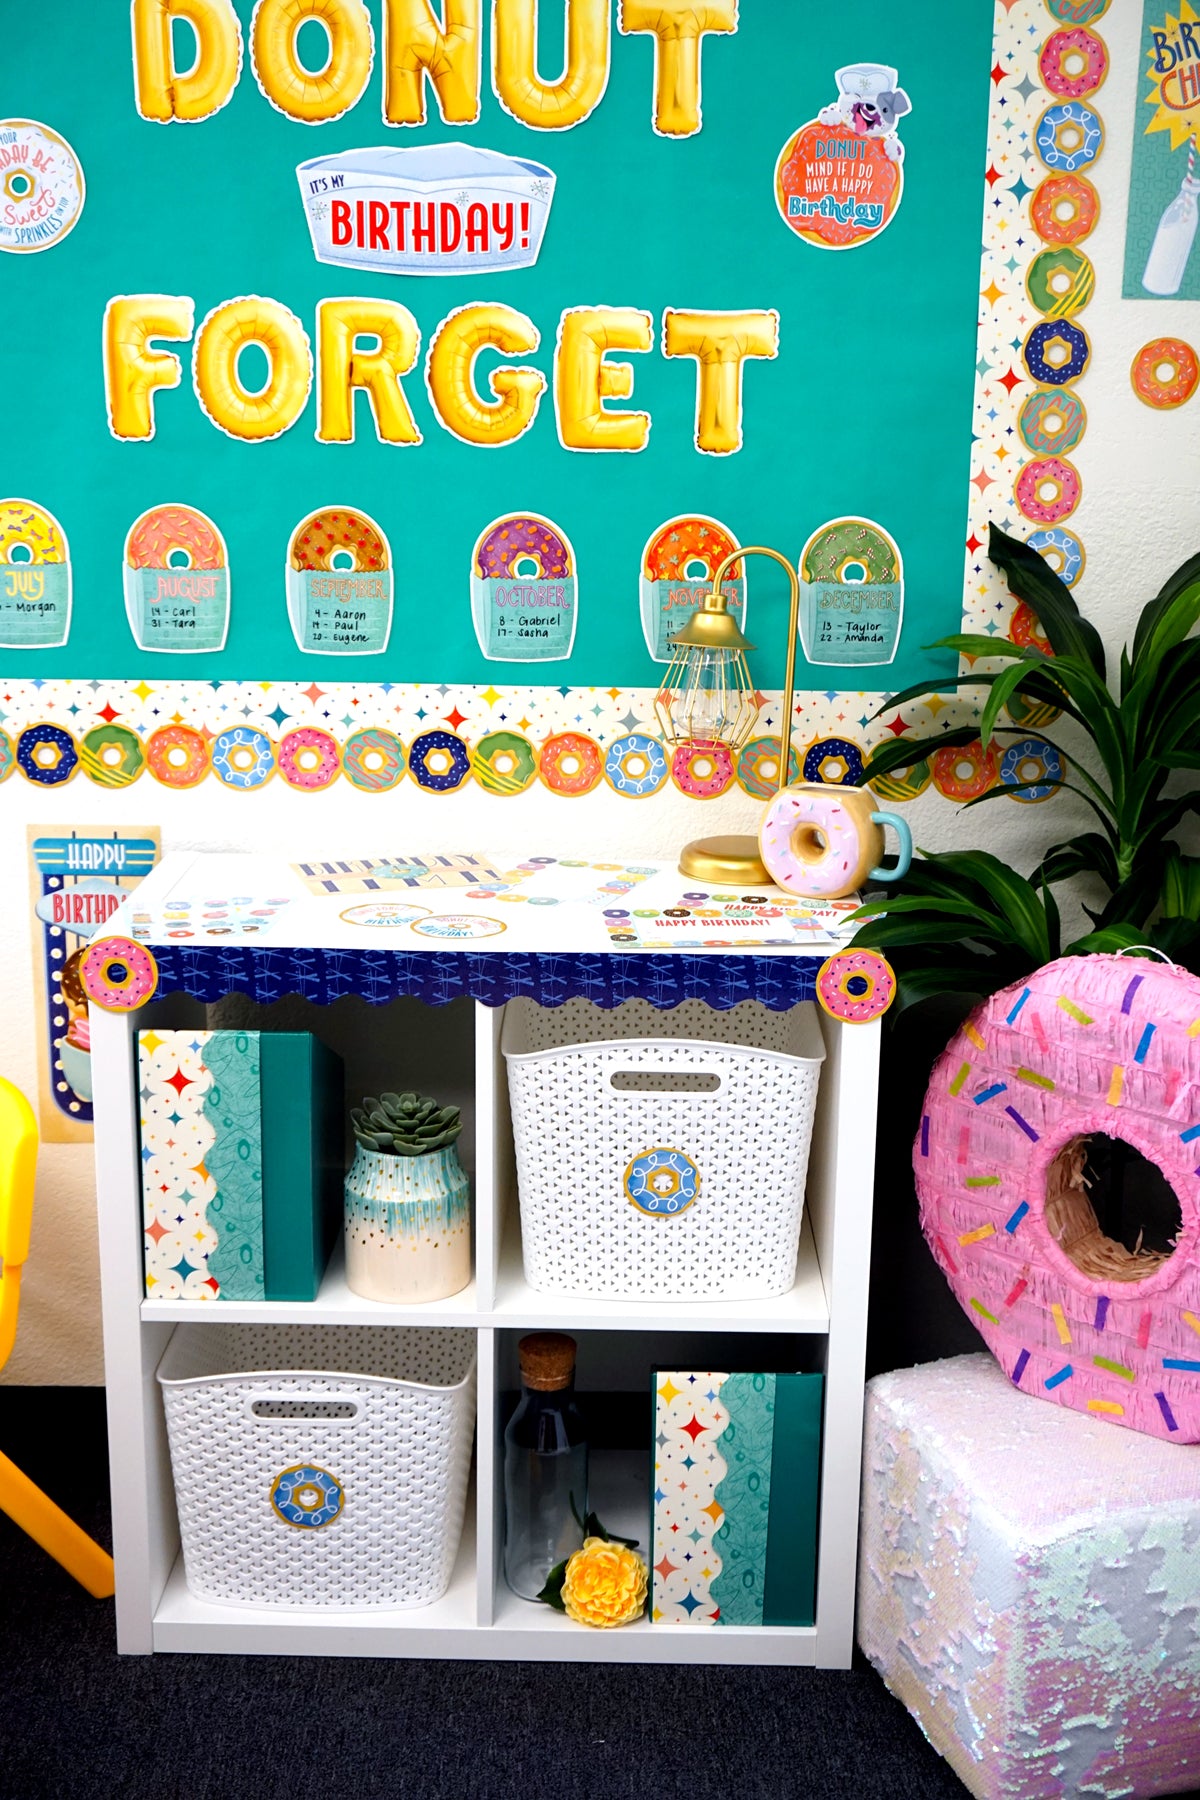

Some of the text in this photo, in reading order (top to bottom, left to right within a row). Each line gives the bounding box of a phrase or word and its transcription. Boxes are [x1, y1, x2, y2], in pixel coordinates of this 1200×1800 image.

[132, 0, 739, 138] DONUT
[815, 139, 867, 160] DONUT
[806, 161, 833, 177] MIND
[837, 161, 848, 176] IF
[858, 163, 873, 179] DO
[310, 175, 344, 194] IT'S MY
[805, 177, 873, 195] HAVE A HAPPY
[789, 195, 884, 229] Birthday
[15, 214, 63, 243] SPRINKLES
[331, 199, 529, 253] BIRTHDAY!
[102, 294, 780, 456] FORGET
[5, 570, 45, 601] JULY
[149, 576, 220, 604] AUGUST
[310, 578, 388, 603] SEPTEMBER
[495, 585, 571, 609] OCTOBER
[820, 589, 897, 615] DECEMBER
[16, 602, 56, 617] Morgan
[151, 606, 161, 616] 14
[172, 606, 196, 617] Carl
[334, 609, 367, 621] Aaron
[151, 619, 161, 628] 31
[334, 621, 359, 631] Paul
[518, 613, 561, 627] Gabriel
[822, 621, 832, 631] 13
[845, 621, 882, 635] Taylor
[333, 633, 370, 645] Eugene
[517, 628, 549, 638] Sasha
[820, 633, 833, 642] 22
[844, 633, 884, 643] Amanda
[66, 843, 125, 870] HAPPY
[53, 894, 126, 923] BIRTHD
[655, 919, 770, 927] HAPPY BIRTHDAY!
